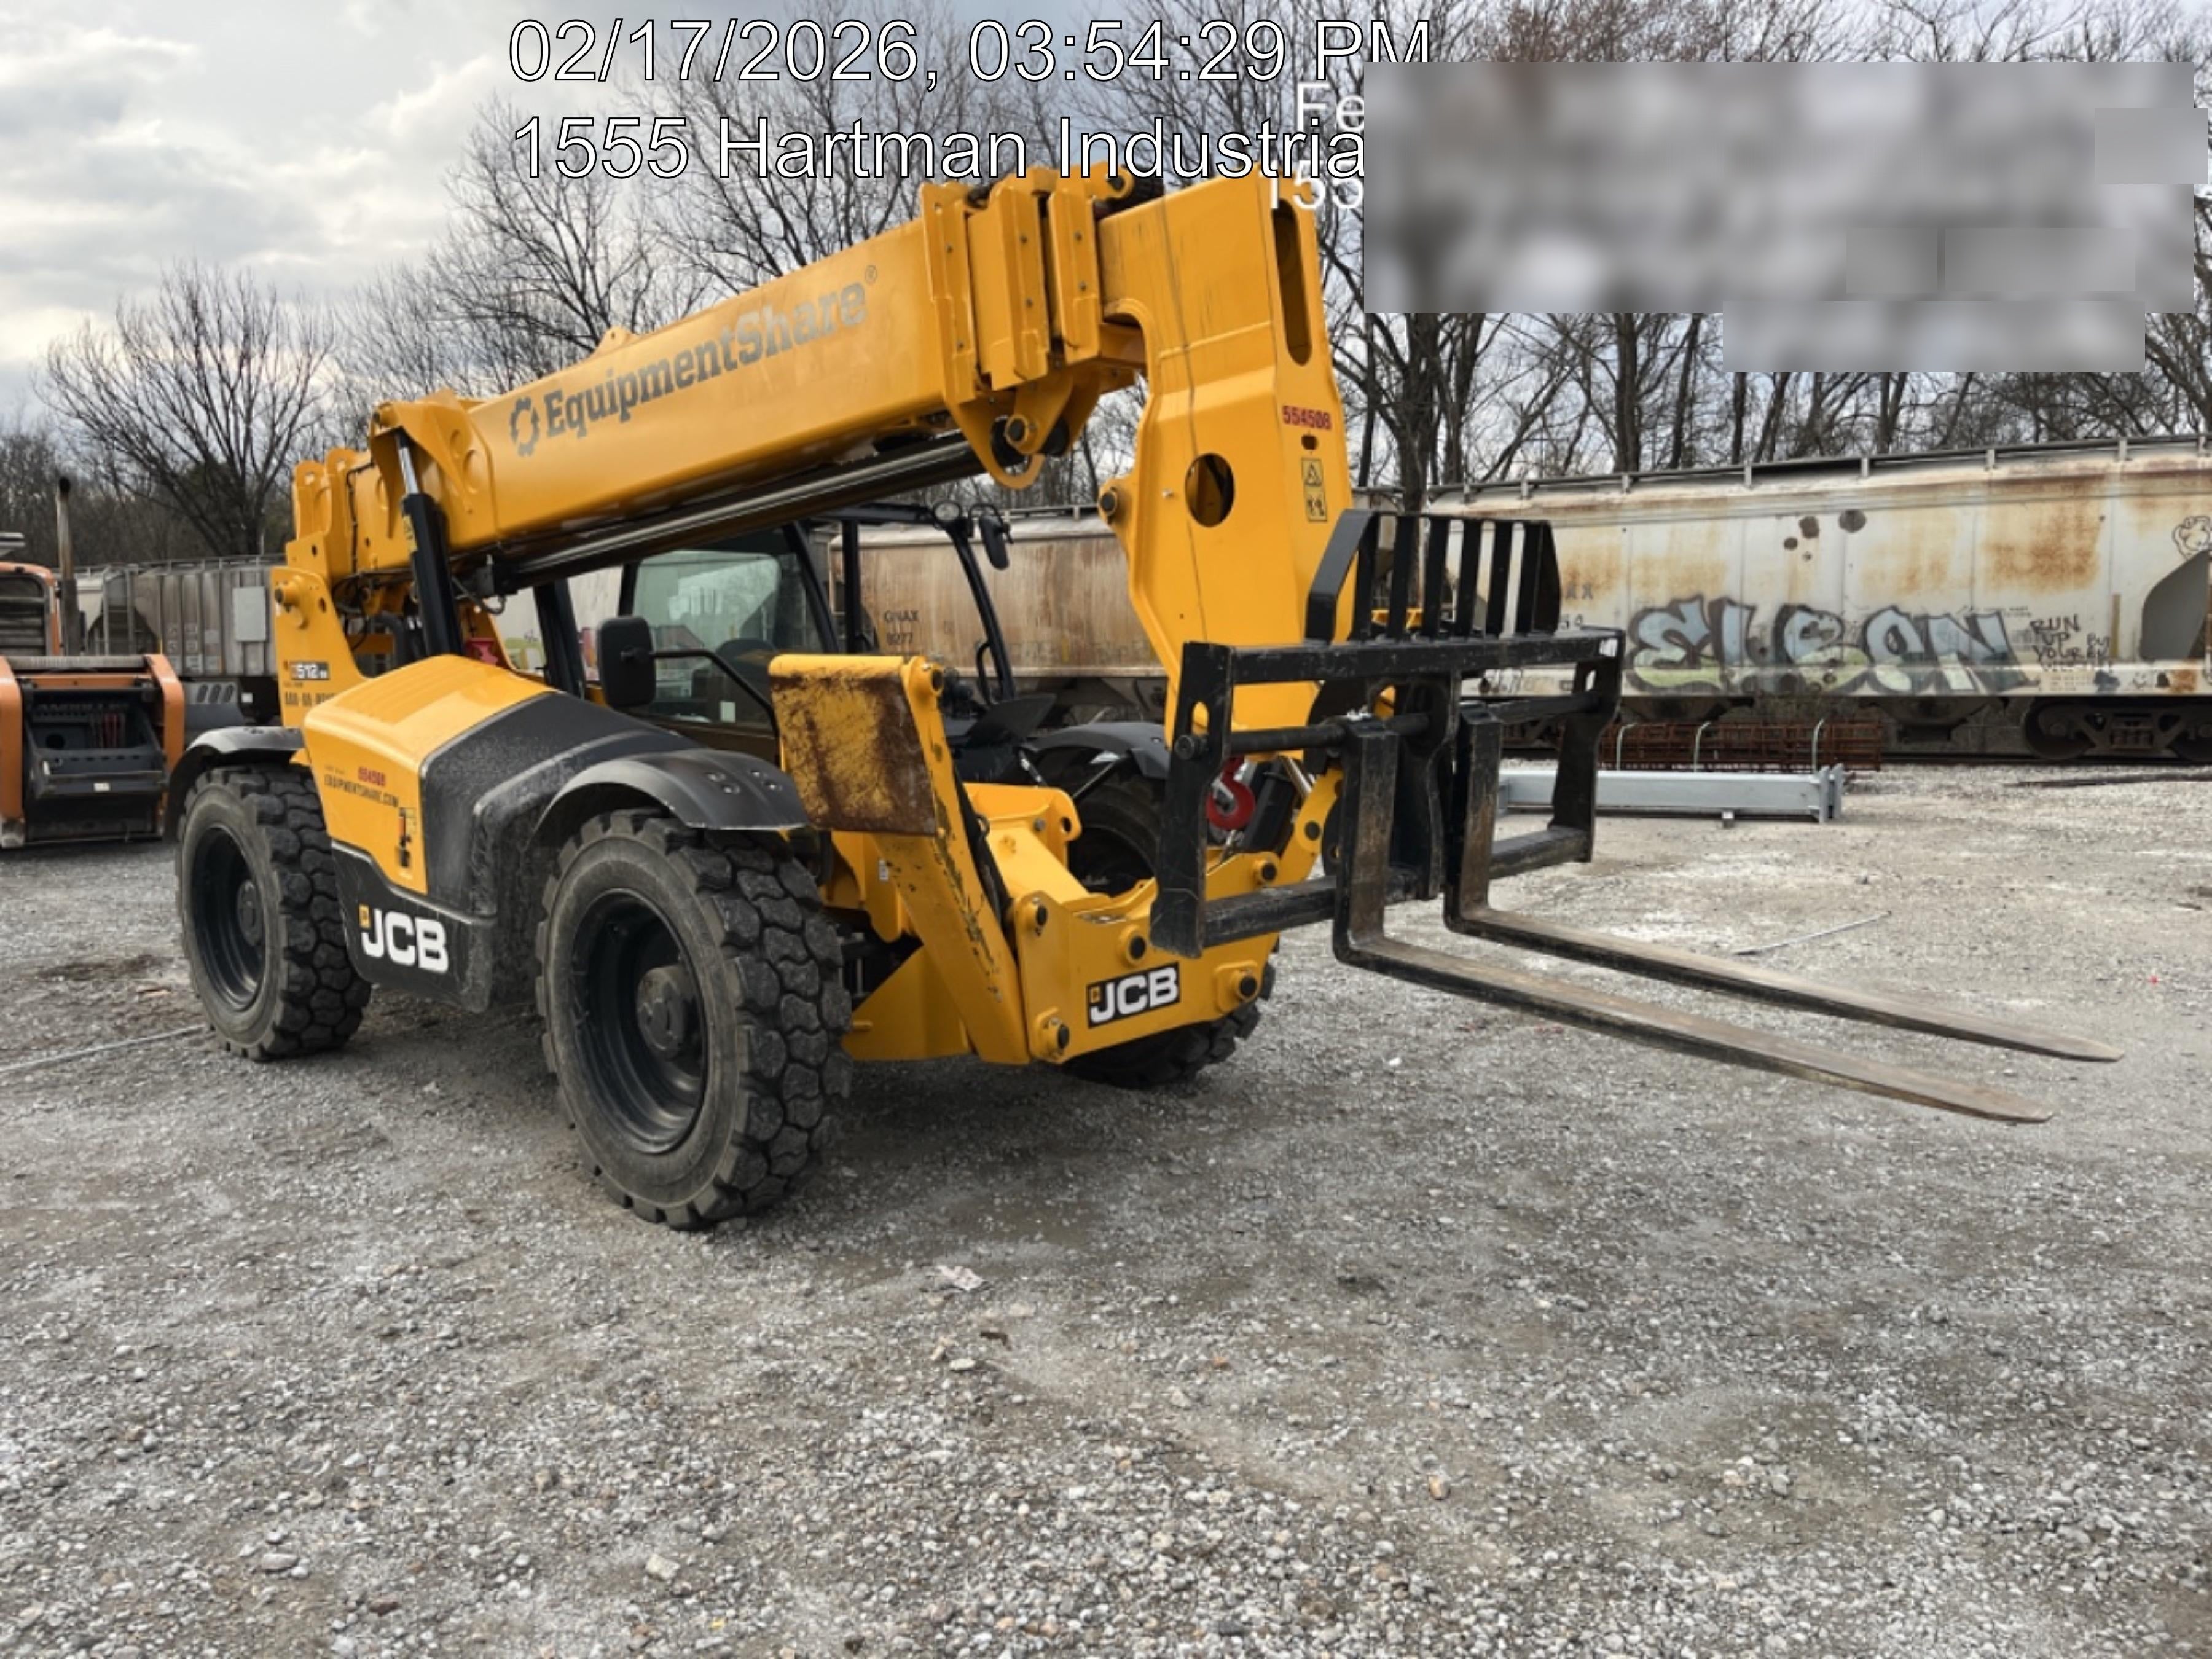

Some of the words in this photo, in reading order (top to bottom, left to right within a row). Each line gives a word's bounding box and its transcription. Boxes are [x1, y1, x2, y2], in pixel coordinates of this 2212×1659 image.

[543, 280, 868, 439] EquipmentShare
[360, 908, 449, 974] JCB
[1090, 967, 1179, 1024] JCB
